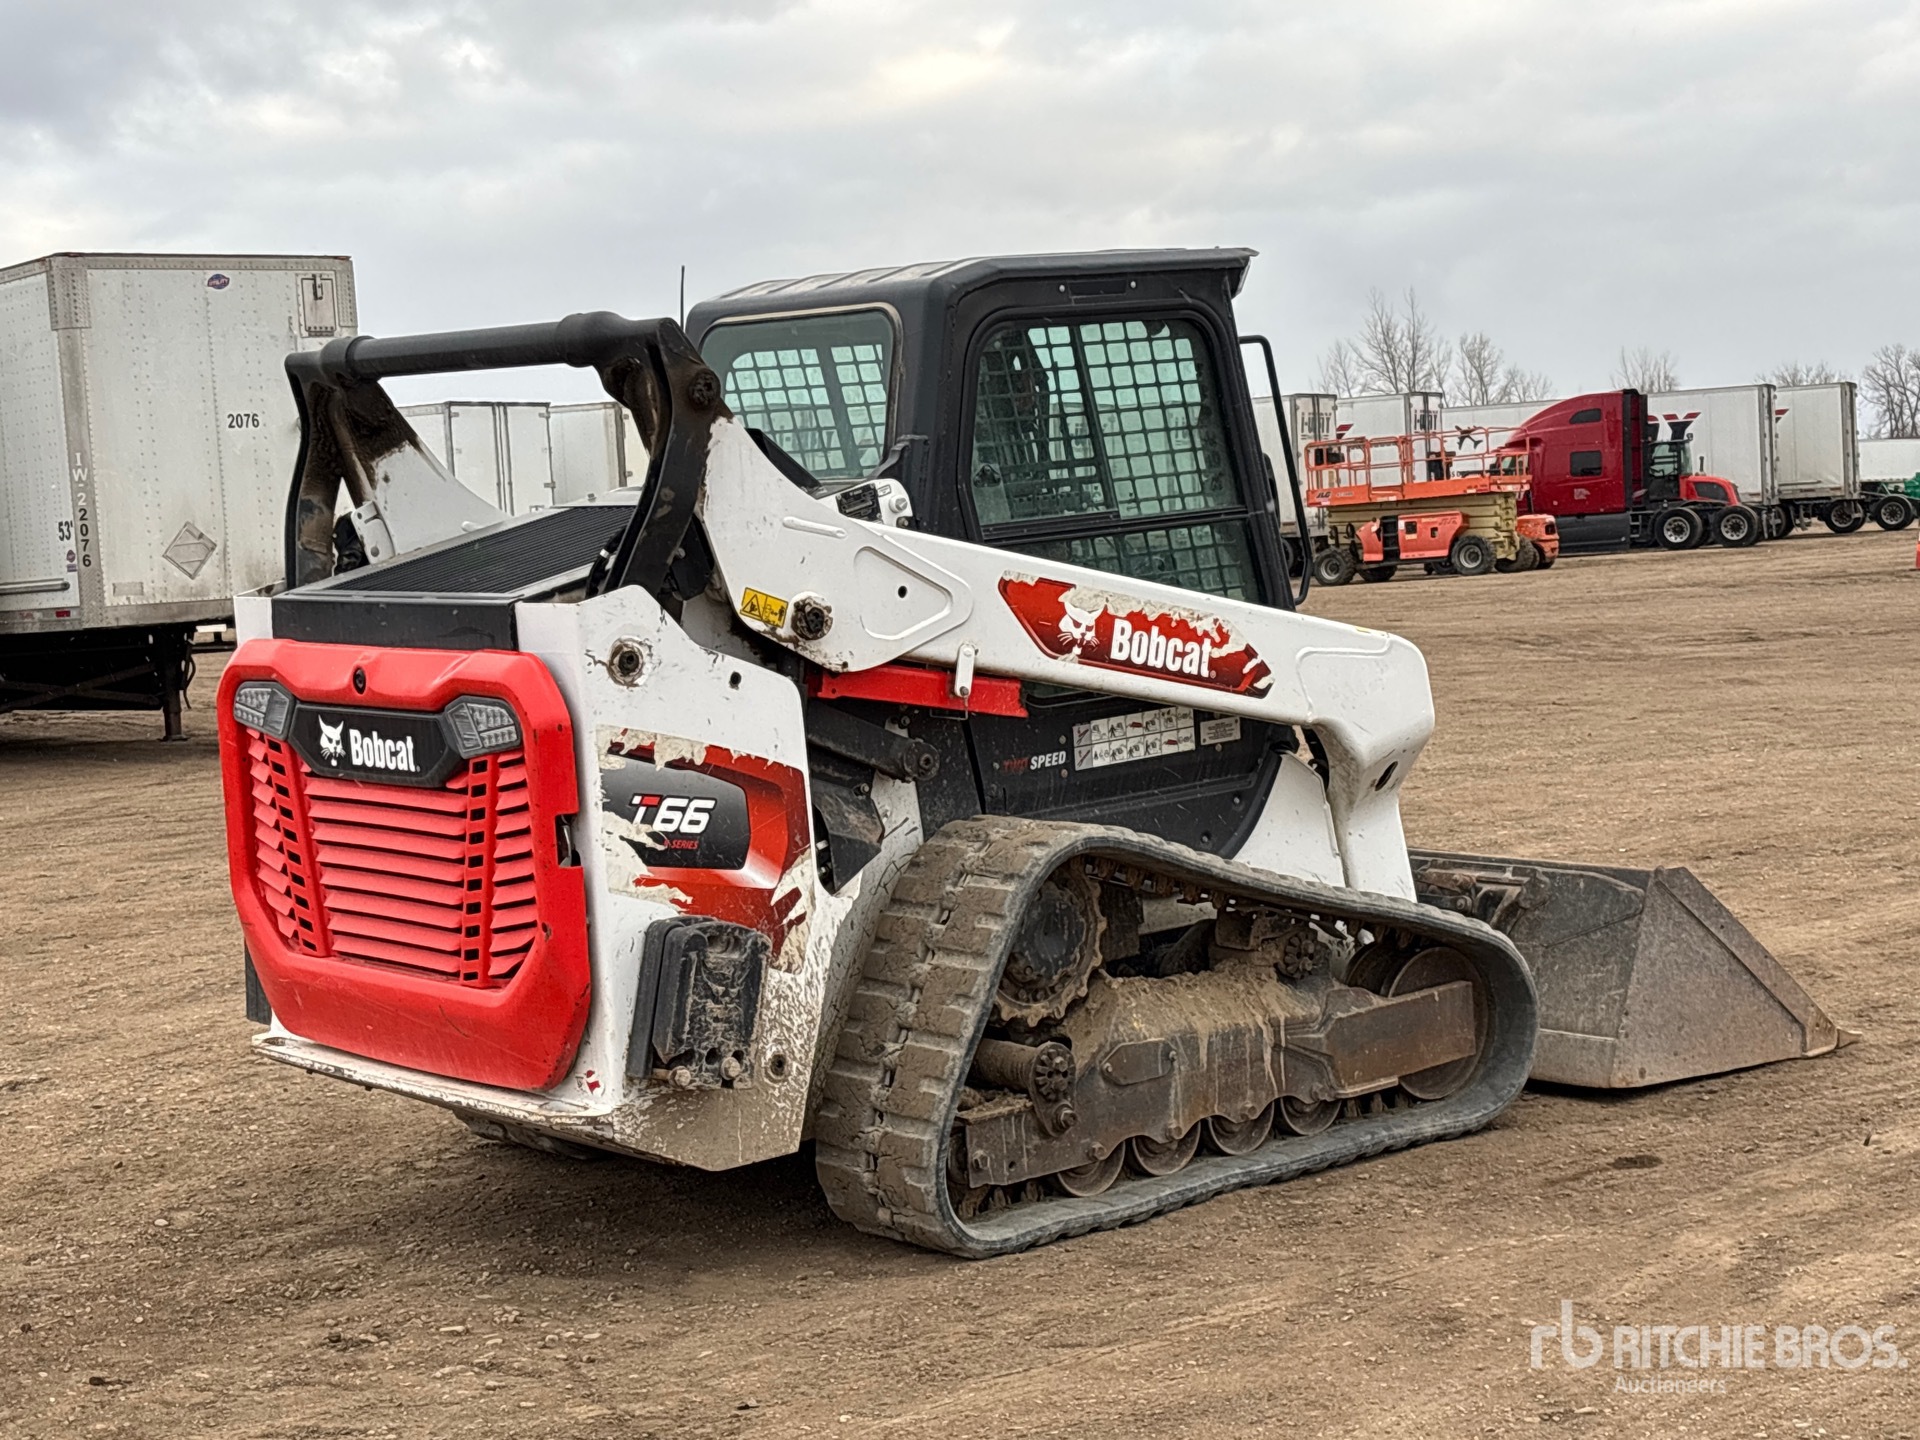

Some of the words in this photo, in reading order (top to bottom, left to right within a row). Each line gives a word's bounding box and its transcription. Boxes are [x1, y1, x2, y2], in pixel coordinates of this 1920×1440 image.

[227, 413, 260, 429] 2076
[1110, 618, 1212, 678] Bobcat
[349, 728, 416, 773] Bobcat
[1030, 750, 1067, 770] SPEED
[632, 795, 716, 834] T66
